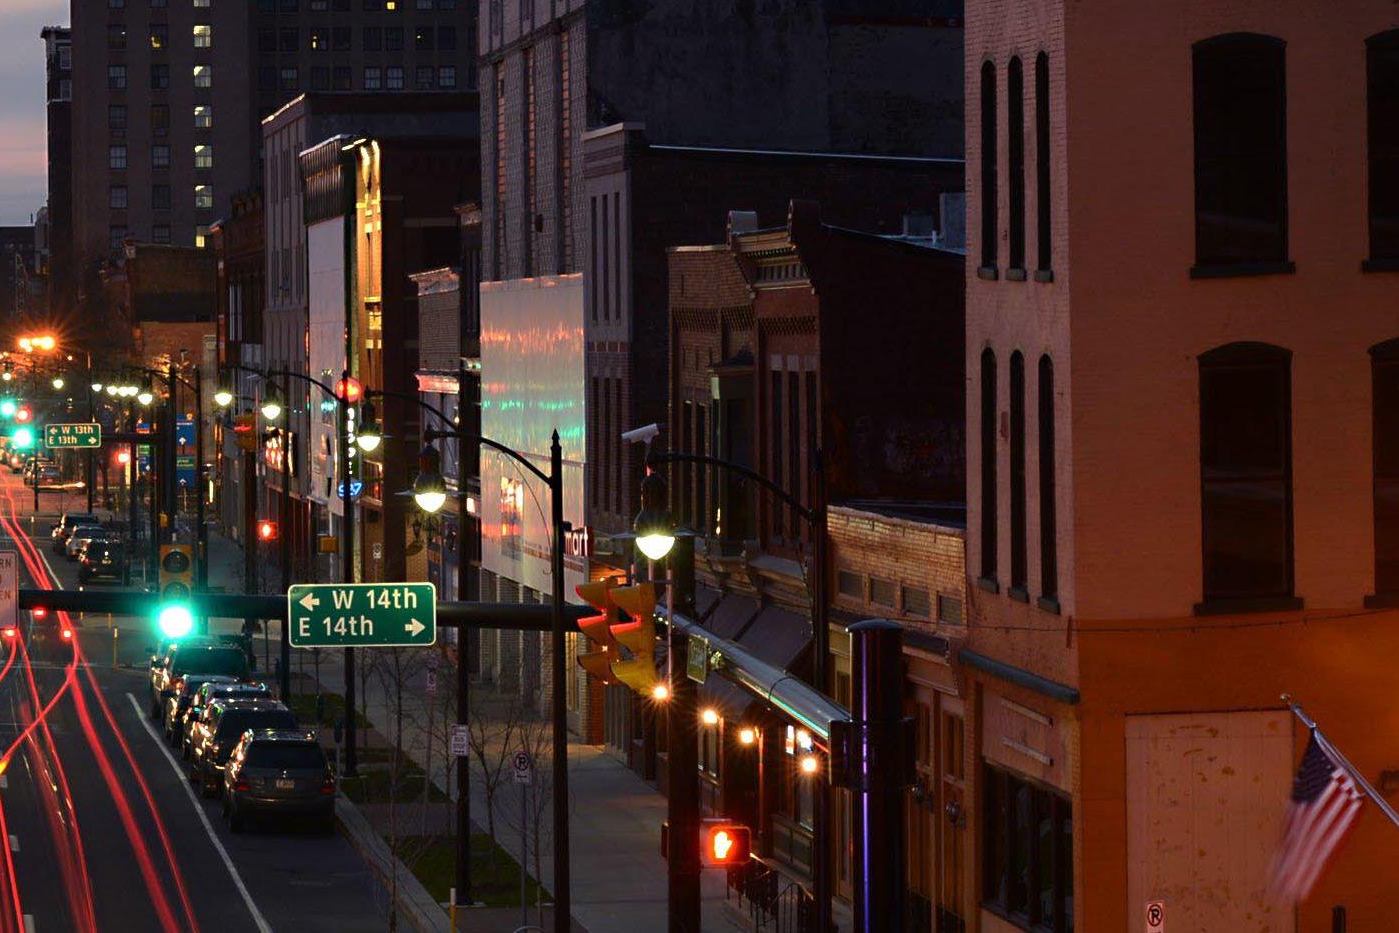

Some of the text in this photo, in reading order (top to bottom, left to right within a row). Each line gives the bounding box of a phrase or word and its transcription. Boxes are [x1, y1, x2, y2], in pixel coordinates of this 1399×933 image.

[61, 425, 94, 434] W 13th
[49, 435, 77, 444] E 13th
[332, 588, 417, 610] W 14th
[299, 615, 374, 637] E 14th
